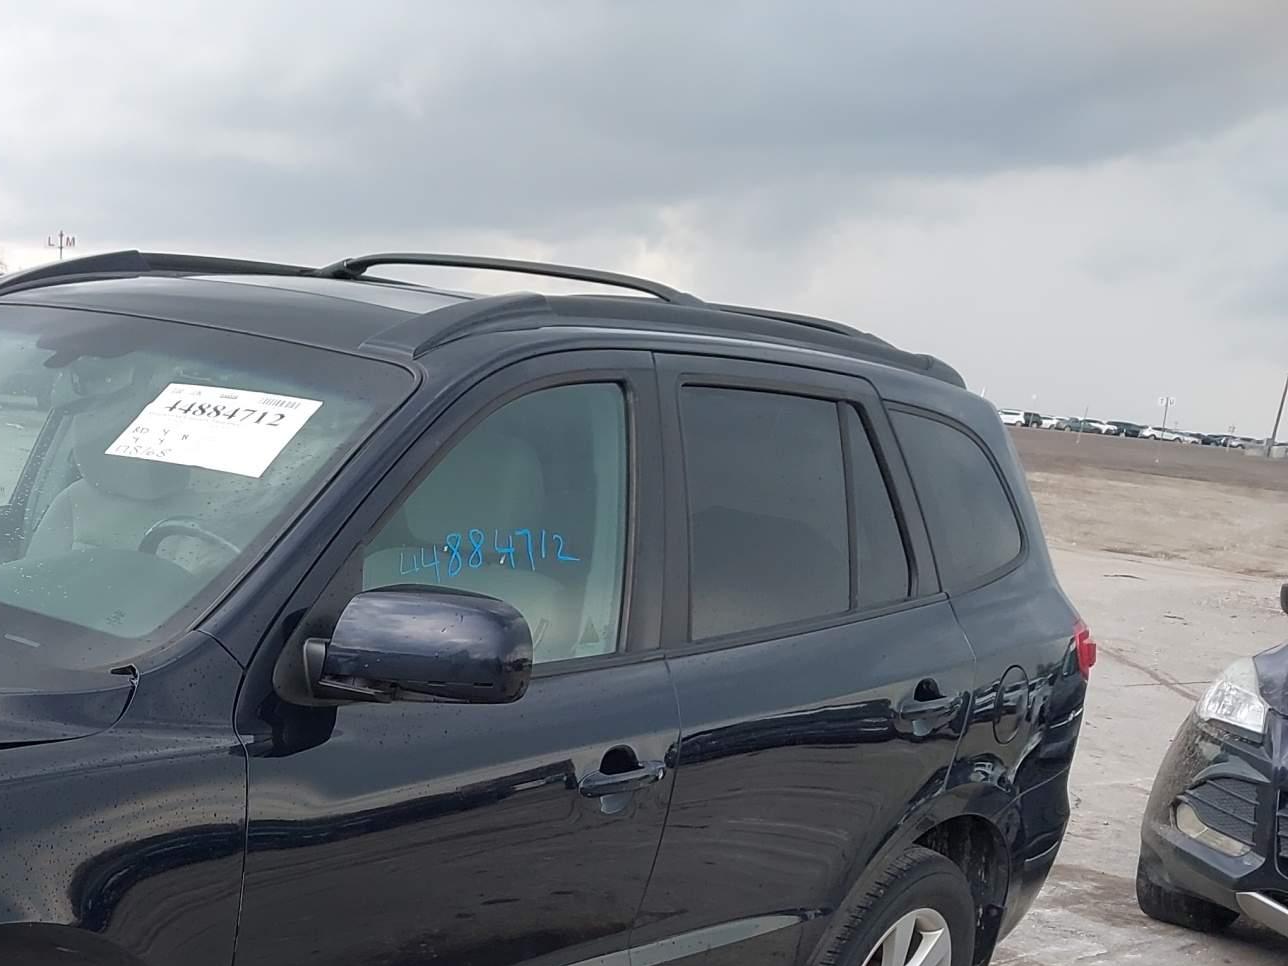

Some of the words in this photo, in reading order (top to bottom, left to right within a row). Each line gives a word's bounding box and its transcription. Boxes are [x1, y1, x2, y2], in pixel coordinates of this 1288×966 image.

[48, 236, 55, 247] L
[66, 236, 76, 247] M
[164, 399, 286, 427] 44884712
[399, 528, 581, 583] 44884712
